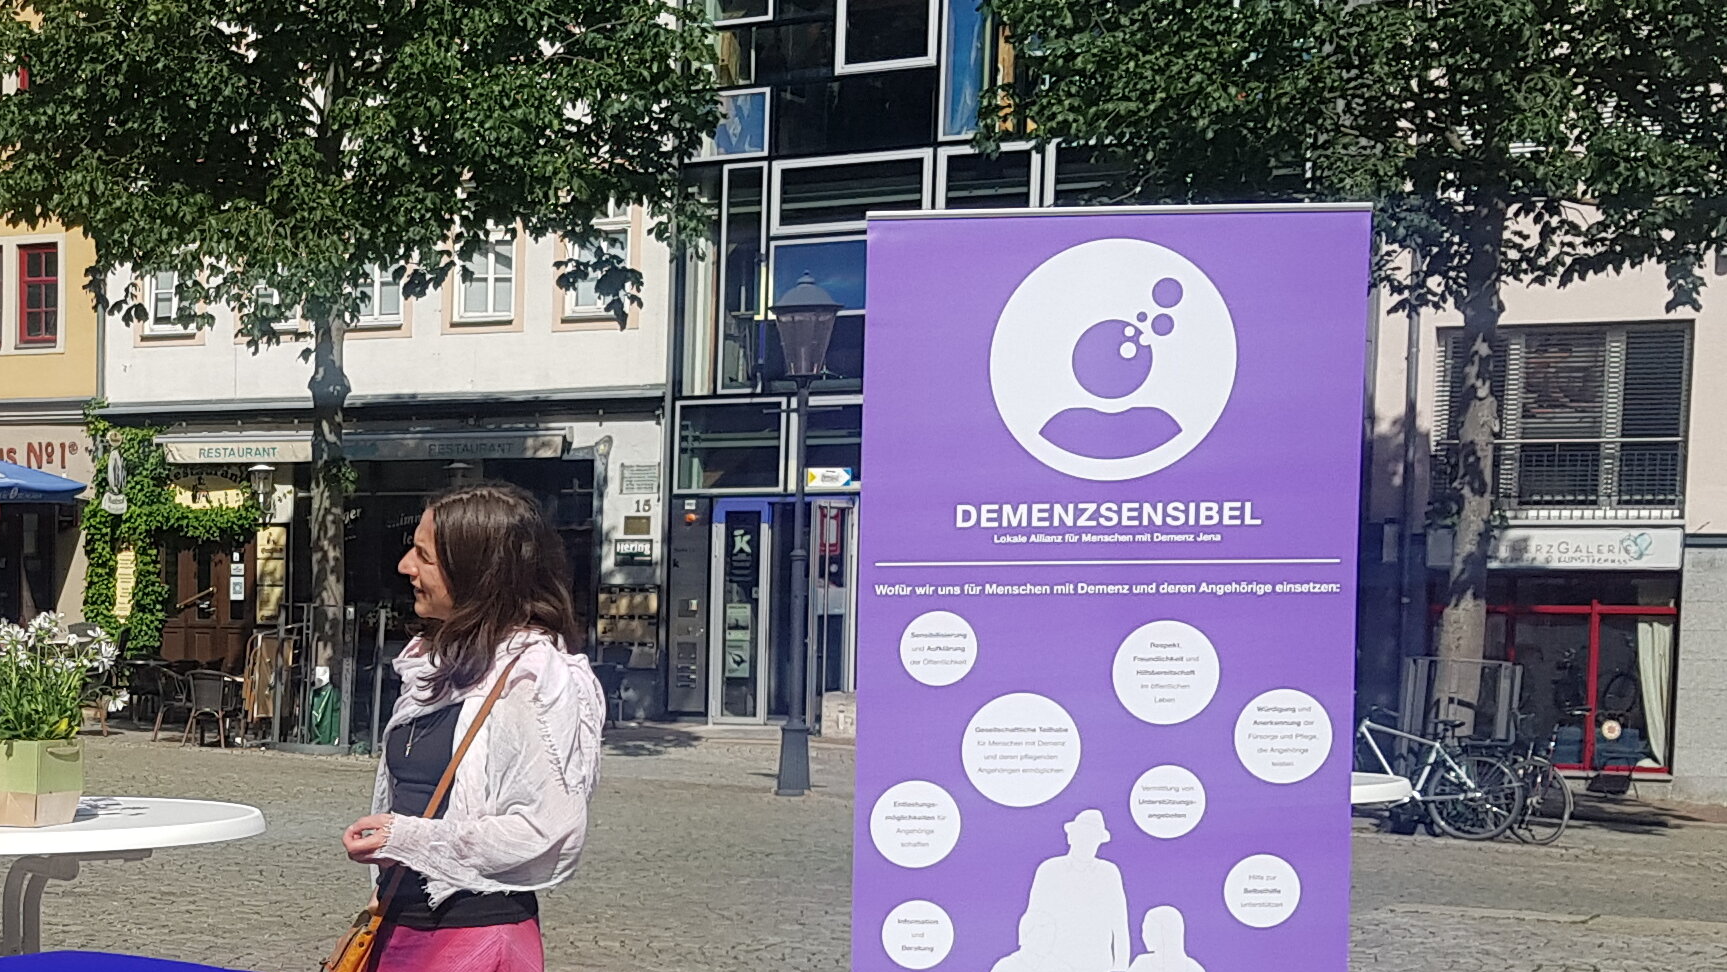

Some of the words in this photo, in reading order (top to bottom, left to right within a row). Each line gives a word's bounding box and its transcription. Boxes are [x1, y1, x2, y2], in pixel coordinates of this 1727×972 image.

[198, 446, 278, 459] RESTAURANT
[428, 442, 514, 457] RESTAURANT
[955, 501, 1262, 528] DEMENZSENSIBEL
[993, 533, 1027, 544] Lokale
[1029, 533, 1063, 544] Allianz
[1065, 533, 1079, 543] für
[1081, 532, 1133, 543] Menschen
[1135, 532, 1151, 542] mit
[1153, 532, 1195, 542] Demenz
[1196, 532, 1221, 542] Jena
[874, 584, 911, 595] Wofür
[915, 584, 935, 595] wir
[937, 586, 960, 595] uns
[964, 584, 982, 595] für
[985, 583, 1050, 595] Menschen
[1053, 583, 1074, 594] mit
[1077, 583, 1129, 594] Demenz
[1132, 583, 1156, 594] und
[1159, 582, 1196, 593] deren
[1199, 582, 1272, 596] Angehörige
[1275, 581, 1340, 593] einsetzen:
